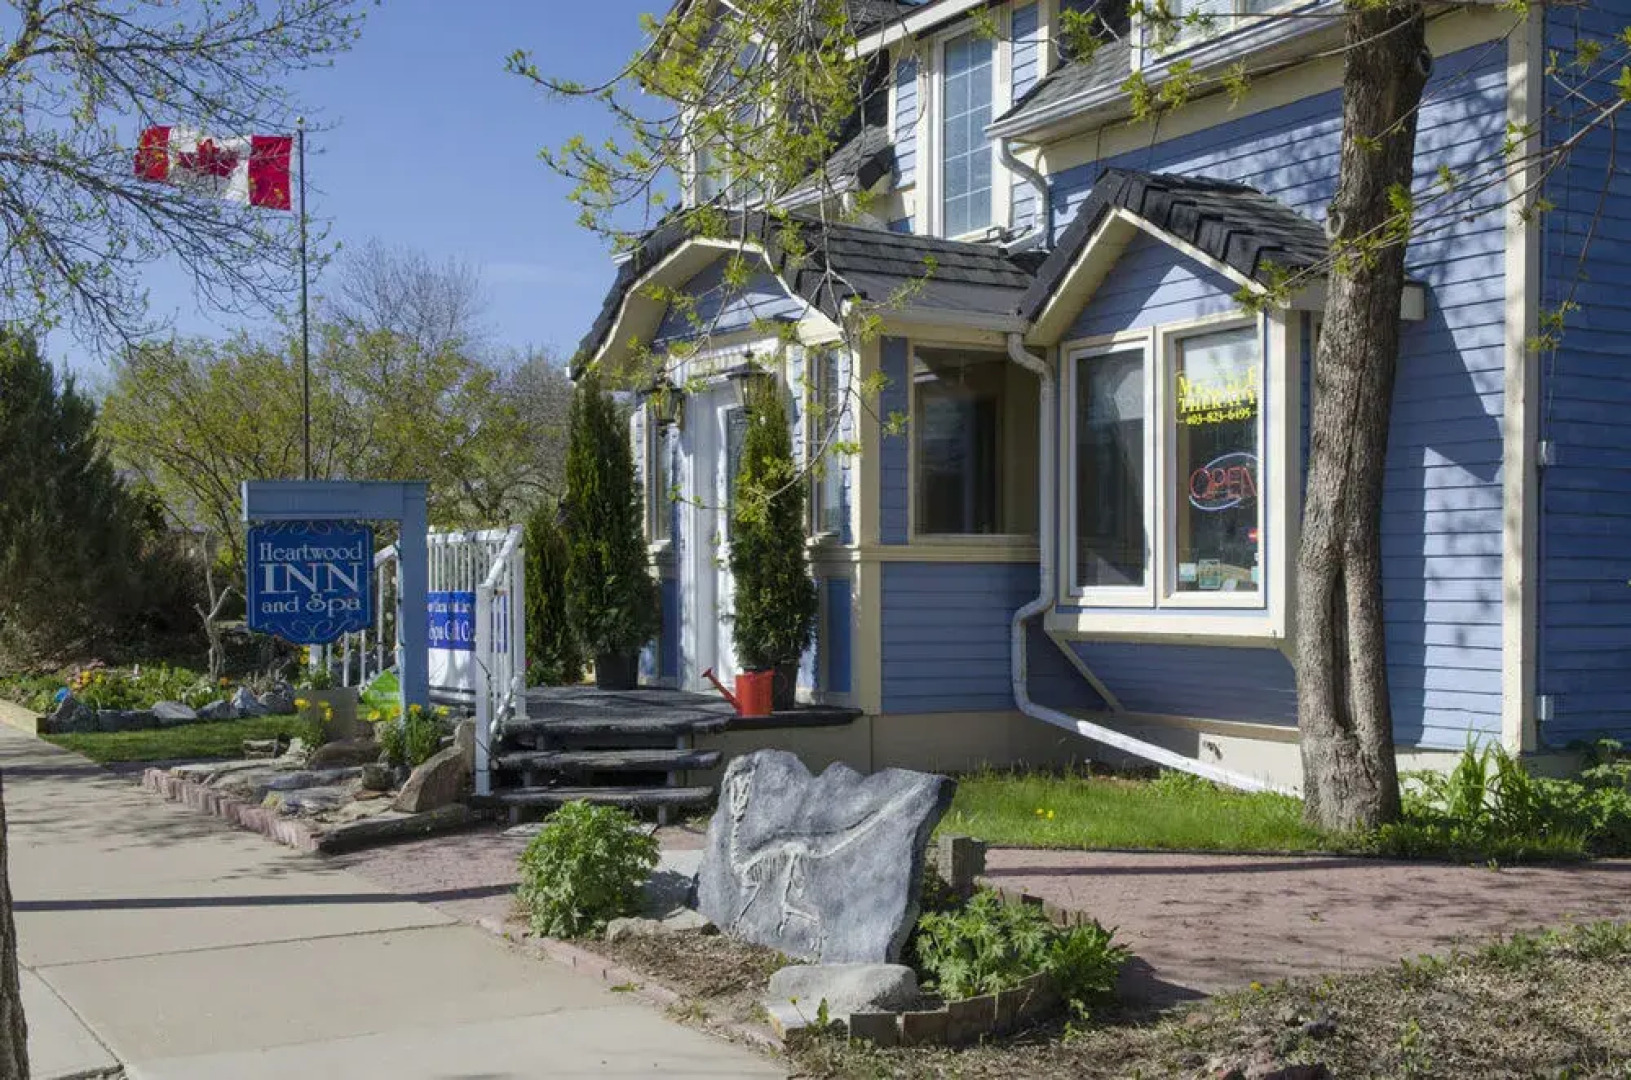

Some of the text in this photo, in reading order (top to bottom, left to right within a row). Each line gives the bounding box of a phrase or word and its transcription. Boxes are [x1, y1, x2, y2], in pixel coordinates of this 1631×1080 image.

[1190, 466, 1257, 500] OPEN
[260, 541, 362, 561] Heartwood
[260, 562, 362, 594] INN
[262, 593, 361, 618] and Spa
